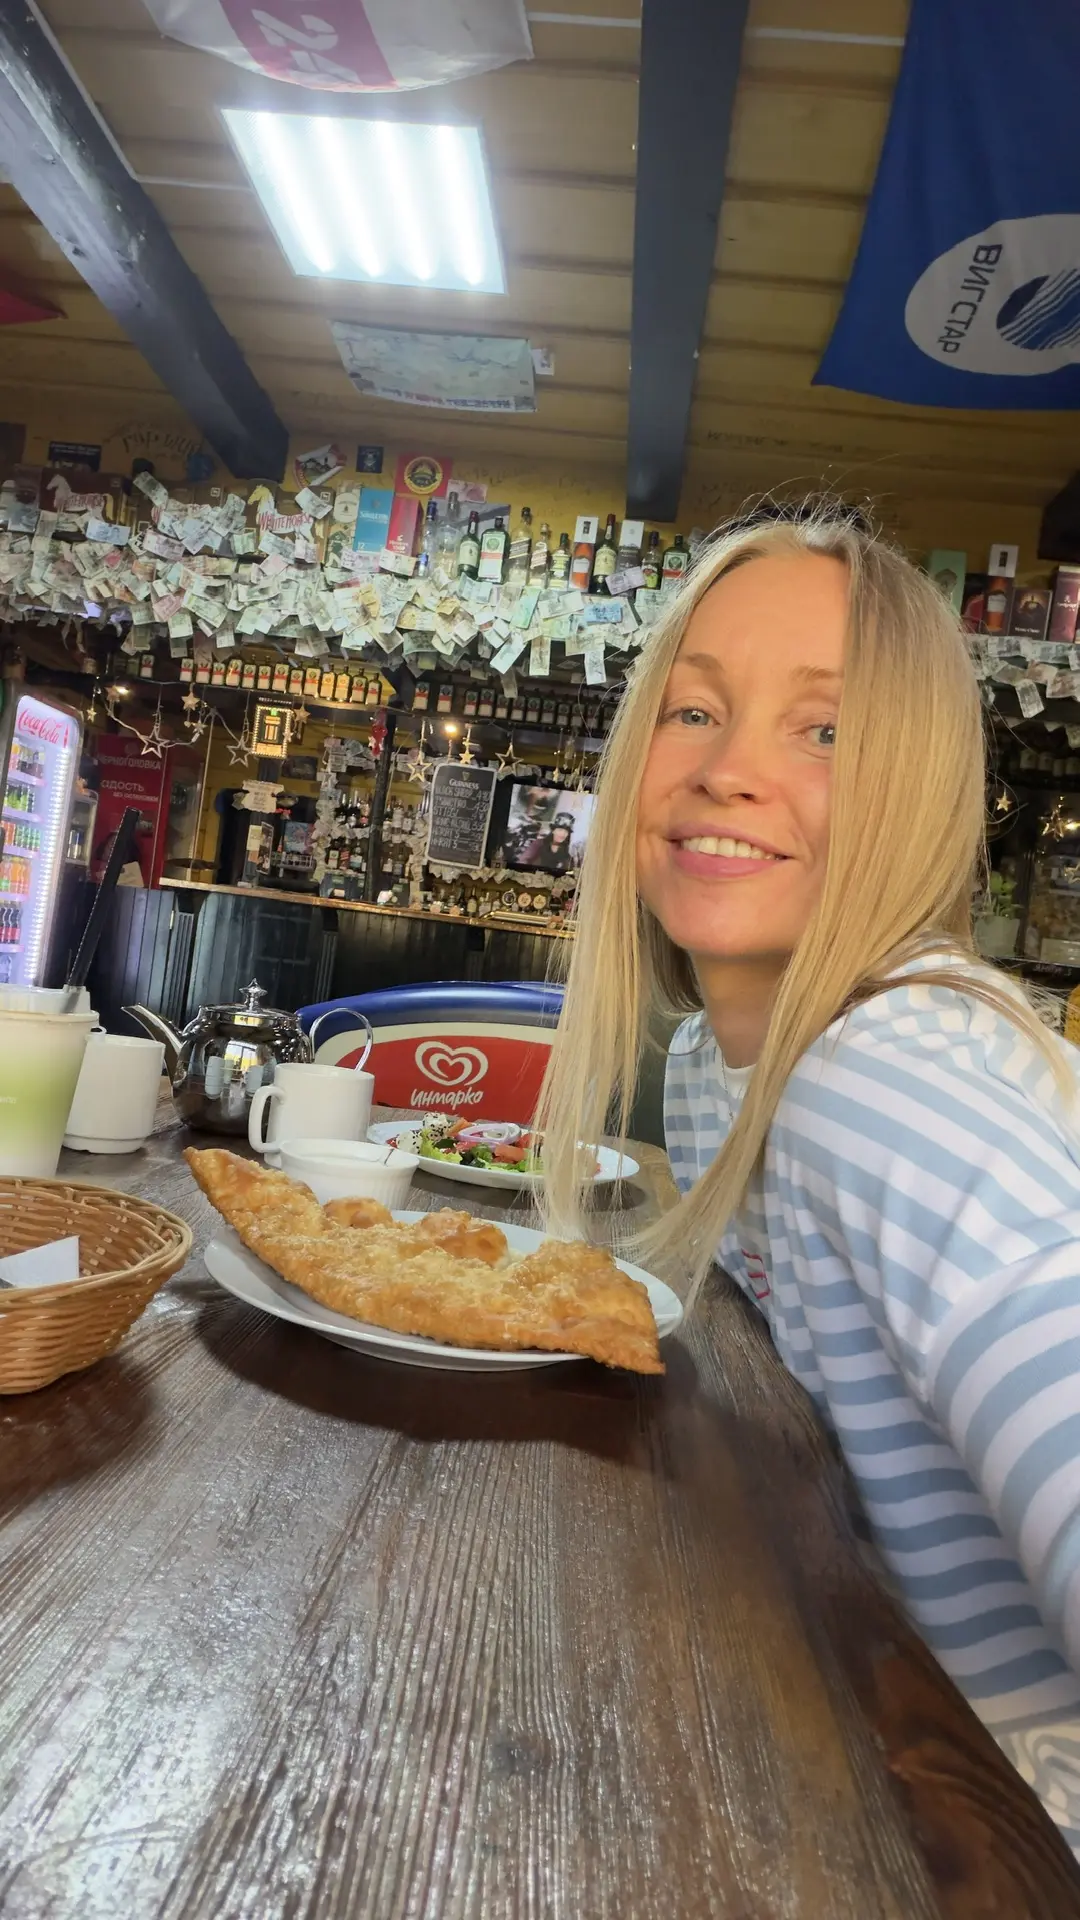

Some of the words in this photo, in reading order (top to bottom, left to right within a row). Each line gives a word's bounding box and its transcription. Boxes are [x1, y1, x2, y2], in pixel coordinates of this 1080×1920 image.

[937, 243, 1003, 354] ВИГСТАР
[100, 755, 162, 770] ЕРНОГОЛОВКА
[101, 779, 145, 793] адость
[450, 779, 479, 790] GUINNESS
[410, 1087, 484, 1111] Инмарко
